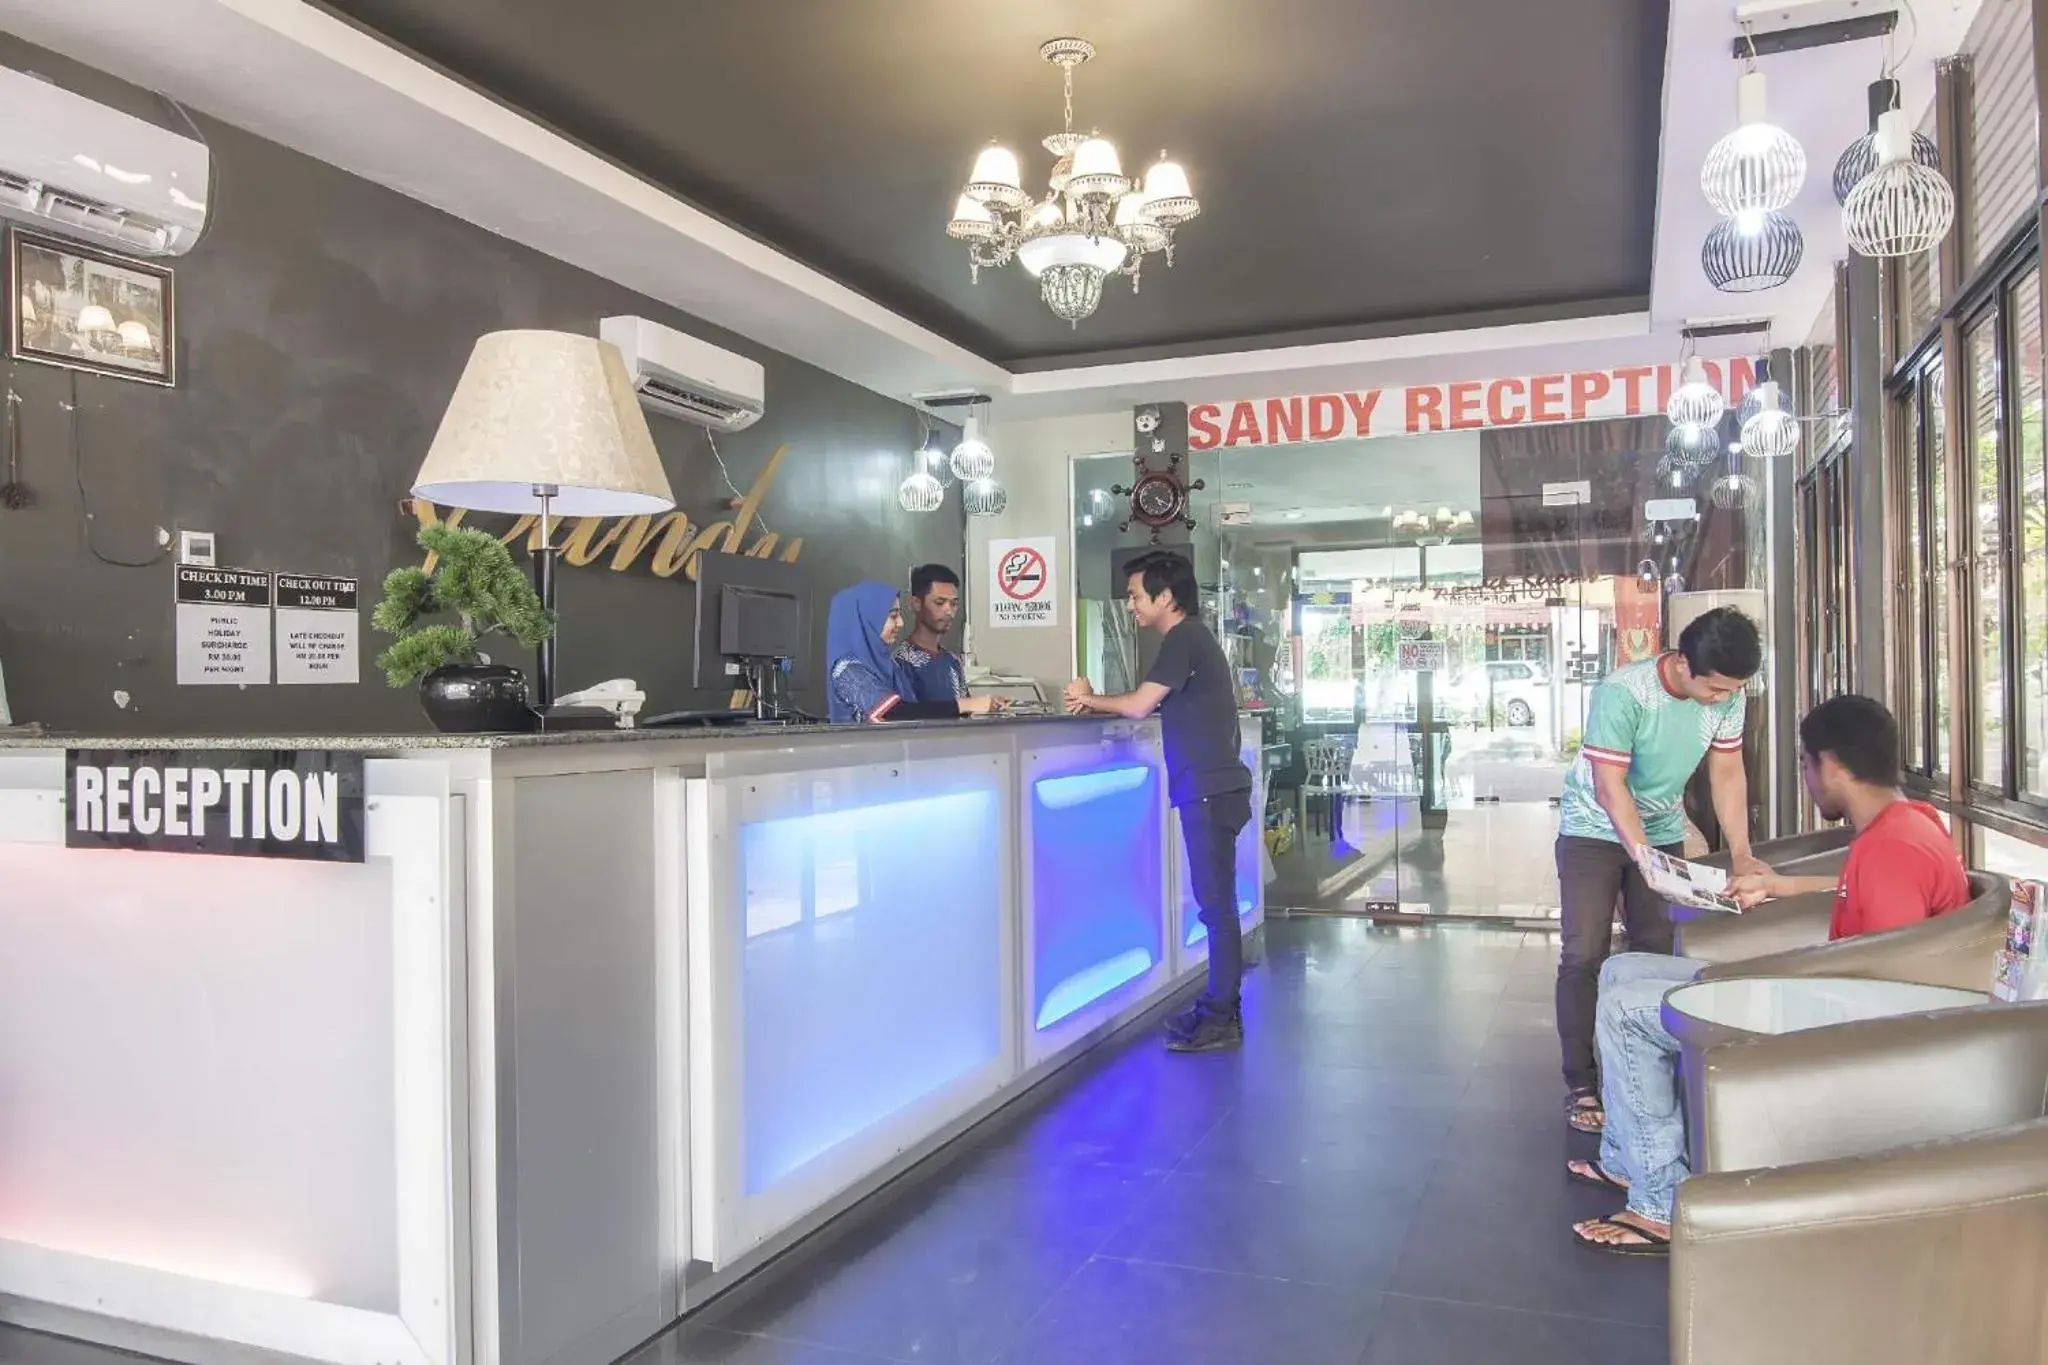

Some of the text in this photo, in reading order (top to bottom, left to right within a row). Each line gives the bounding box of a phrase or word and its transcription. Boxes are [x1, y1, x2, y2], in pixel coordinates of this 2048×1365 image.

[1188, 389, 1382, 450] SANDY
[180, 570, 268, 587] CHECK IN TIME
[279, 578, 356, 594] CHECK OUT TIME
[204, 589, 246, 601] 3.00 PM
[322, 596, 336, 607] PM
[210, 617, 239, 625] PUBLIC
[208, 629, 241, 637] HOLIDAY
[290, 632, 307, 640] LATE
[201, 641, 248, 649] SURCHARGE
[290, 642, 306, 650] WILL
[204, 665, 220, 673] PER
[76, 766, 339, 843] RECEPTION
